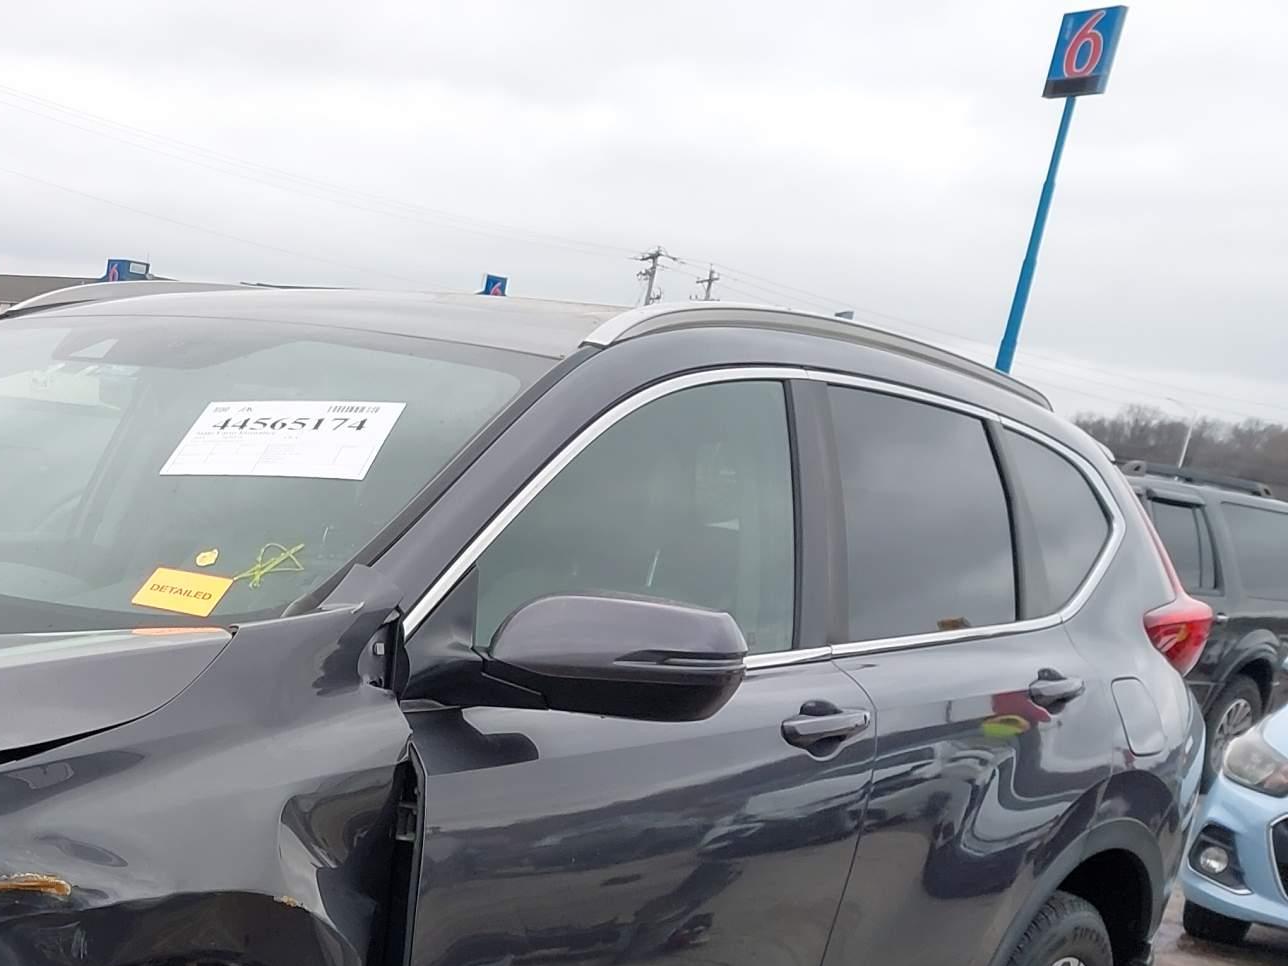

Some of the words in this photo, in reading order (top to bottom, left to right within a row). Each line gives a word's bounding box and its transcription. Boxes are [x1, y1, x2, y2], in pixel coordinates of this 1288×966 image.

[1063, 9, 1106, 78] 6
[211, 416, 369, 432] 44565174
[149, 582, 213, 602] DETAILED
